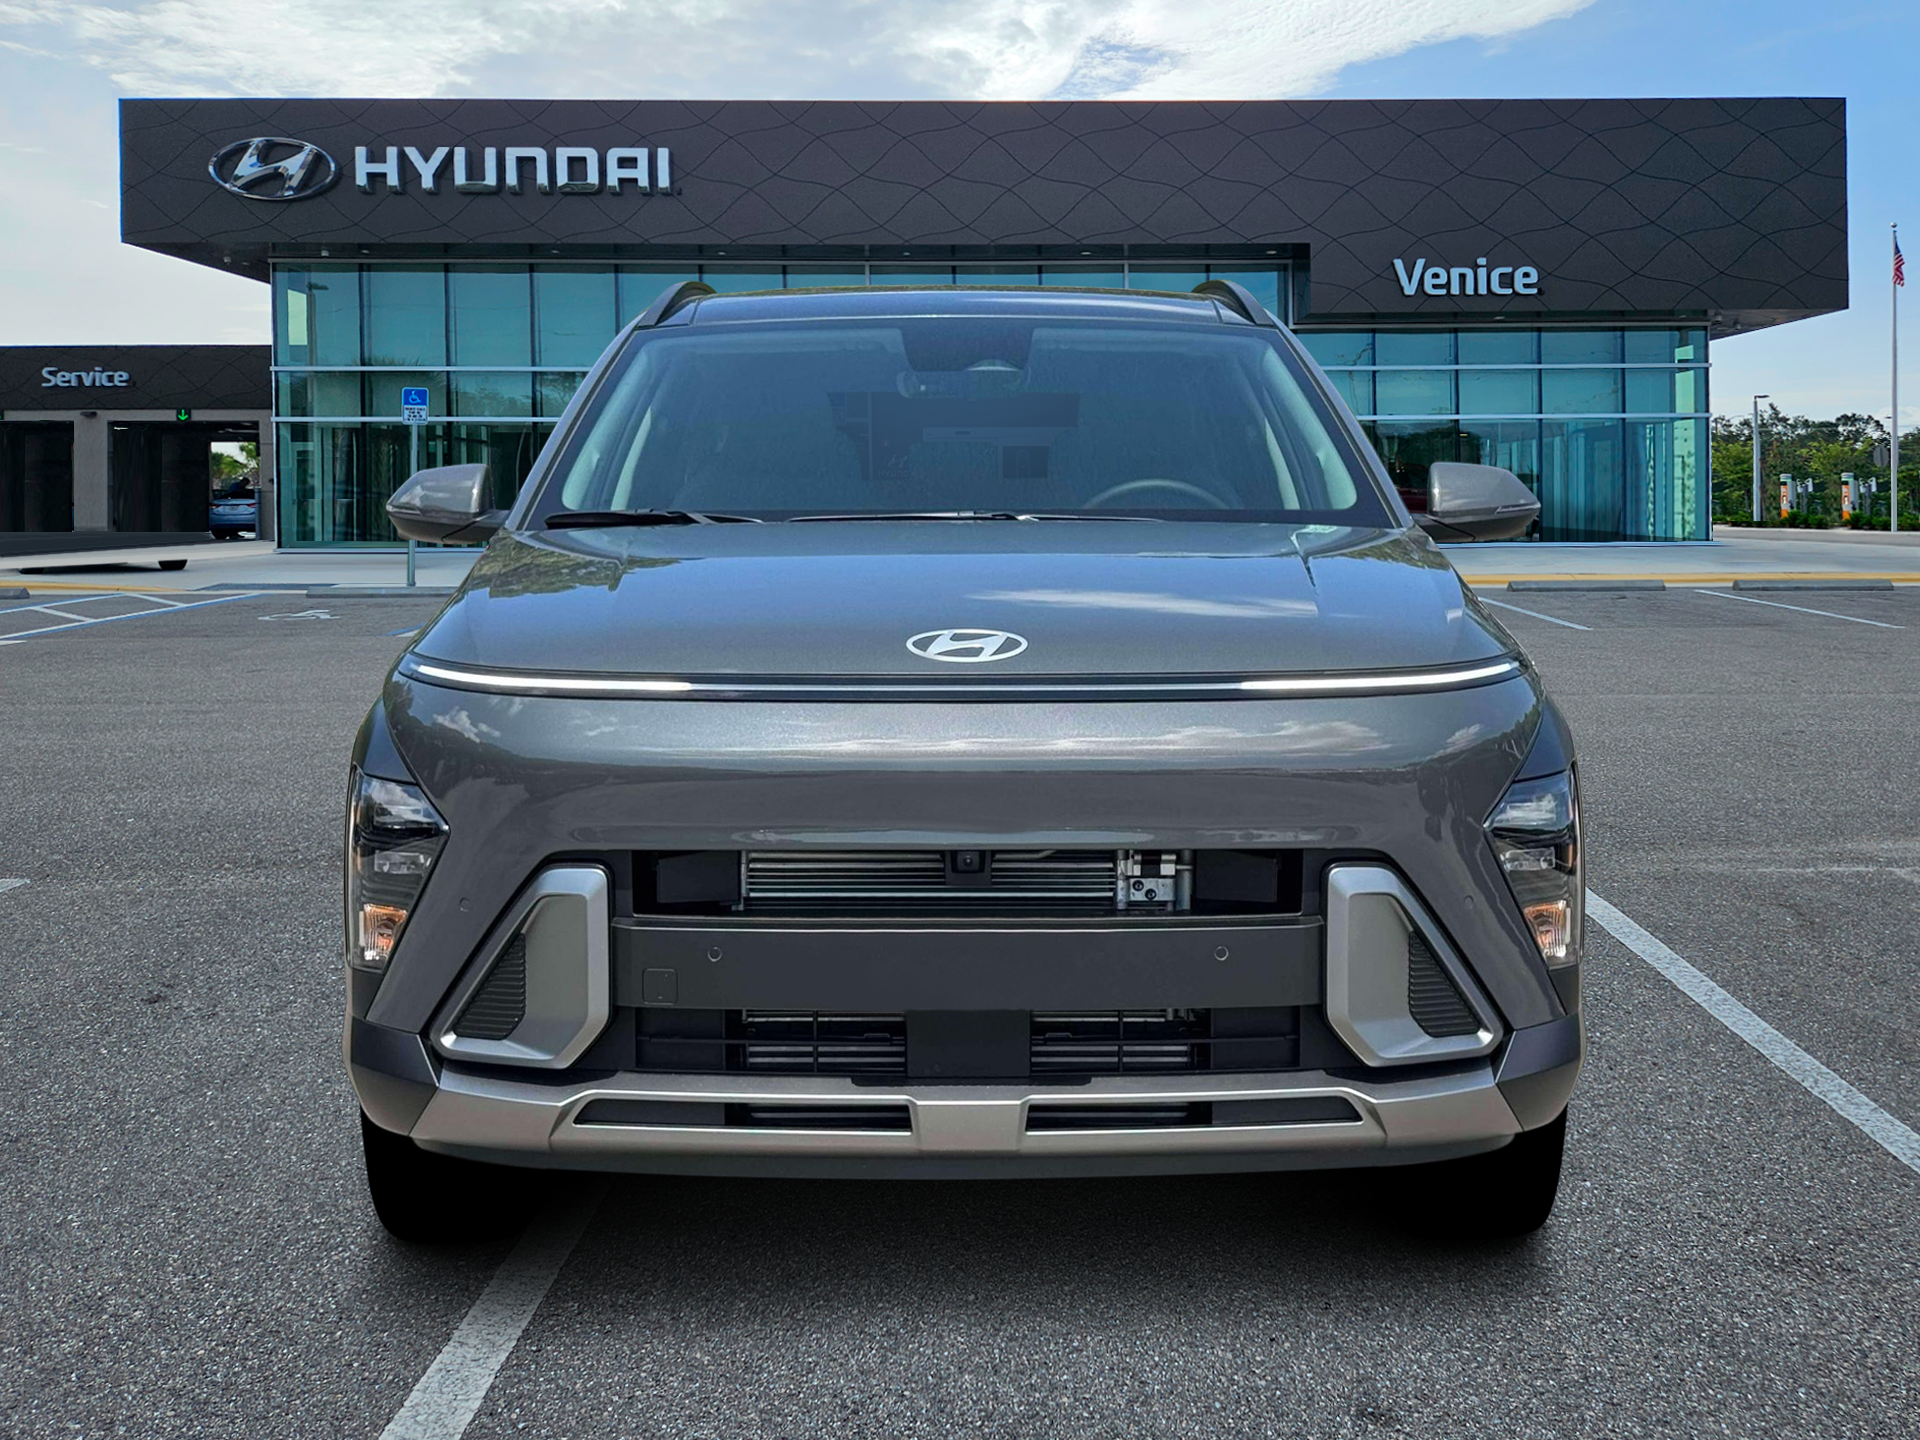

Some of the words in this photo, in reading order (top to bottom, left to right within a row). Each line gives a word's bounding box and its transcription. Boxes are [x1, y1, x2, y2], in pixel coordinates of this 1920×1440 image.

[354, 146, 671, 193] HYUNDAI
[1392, 257, 1540, 296] Venice
[41, 366, 130, 387] Service
